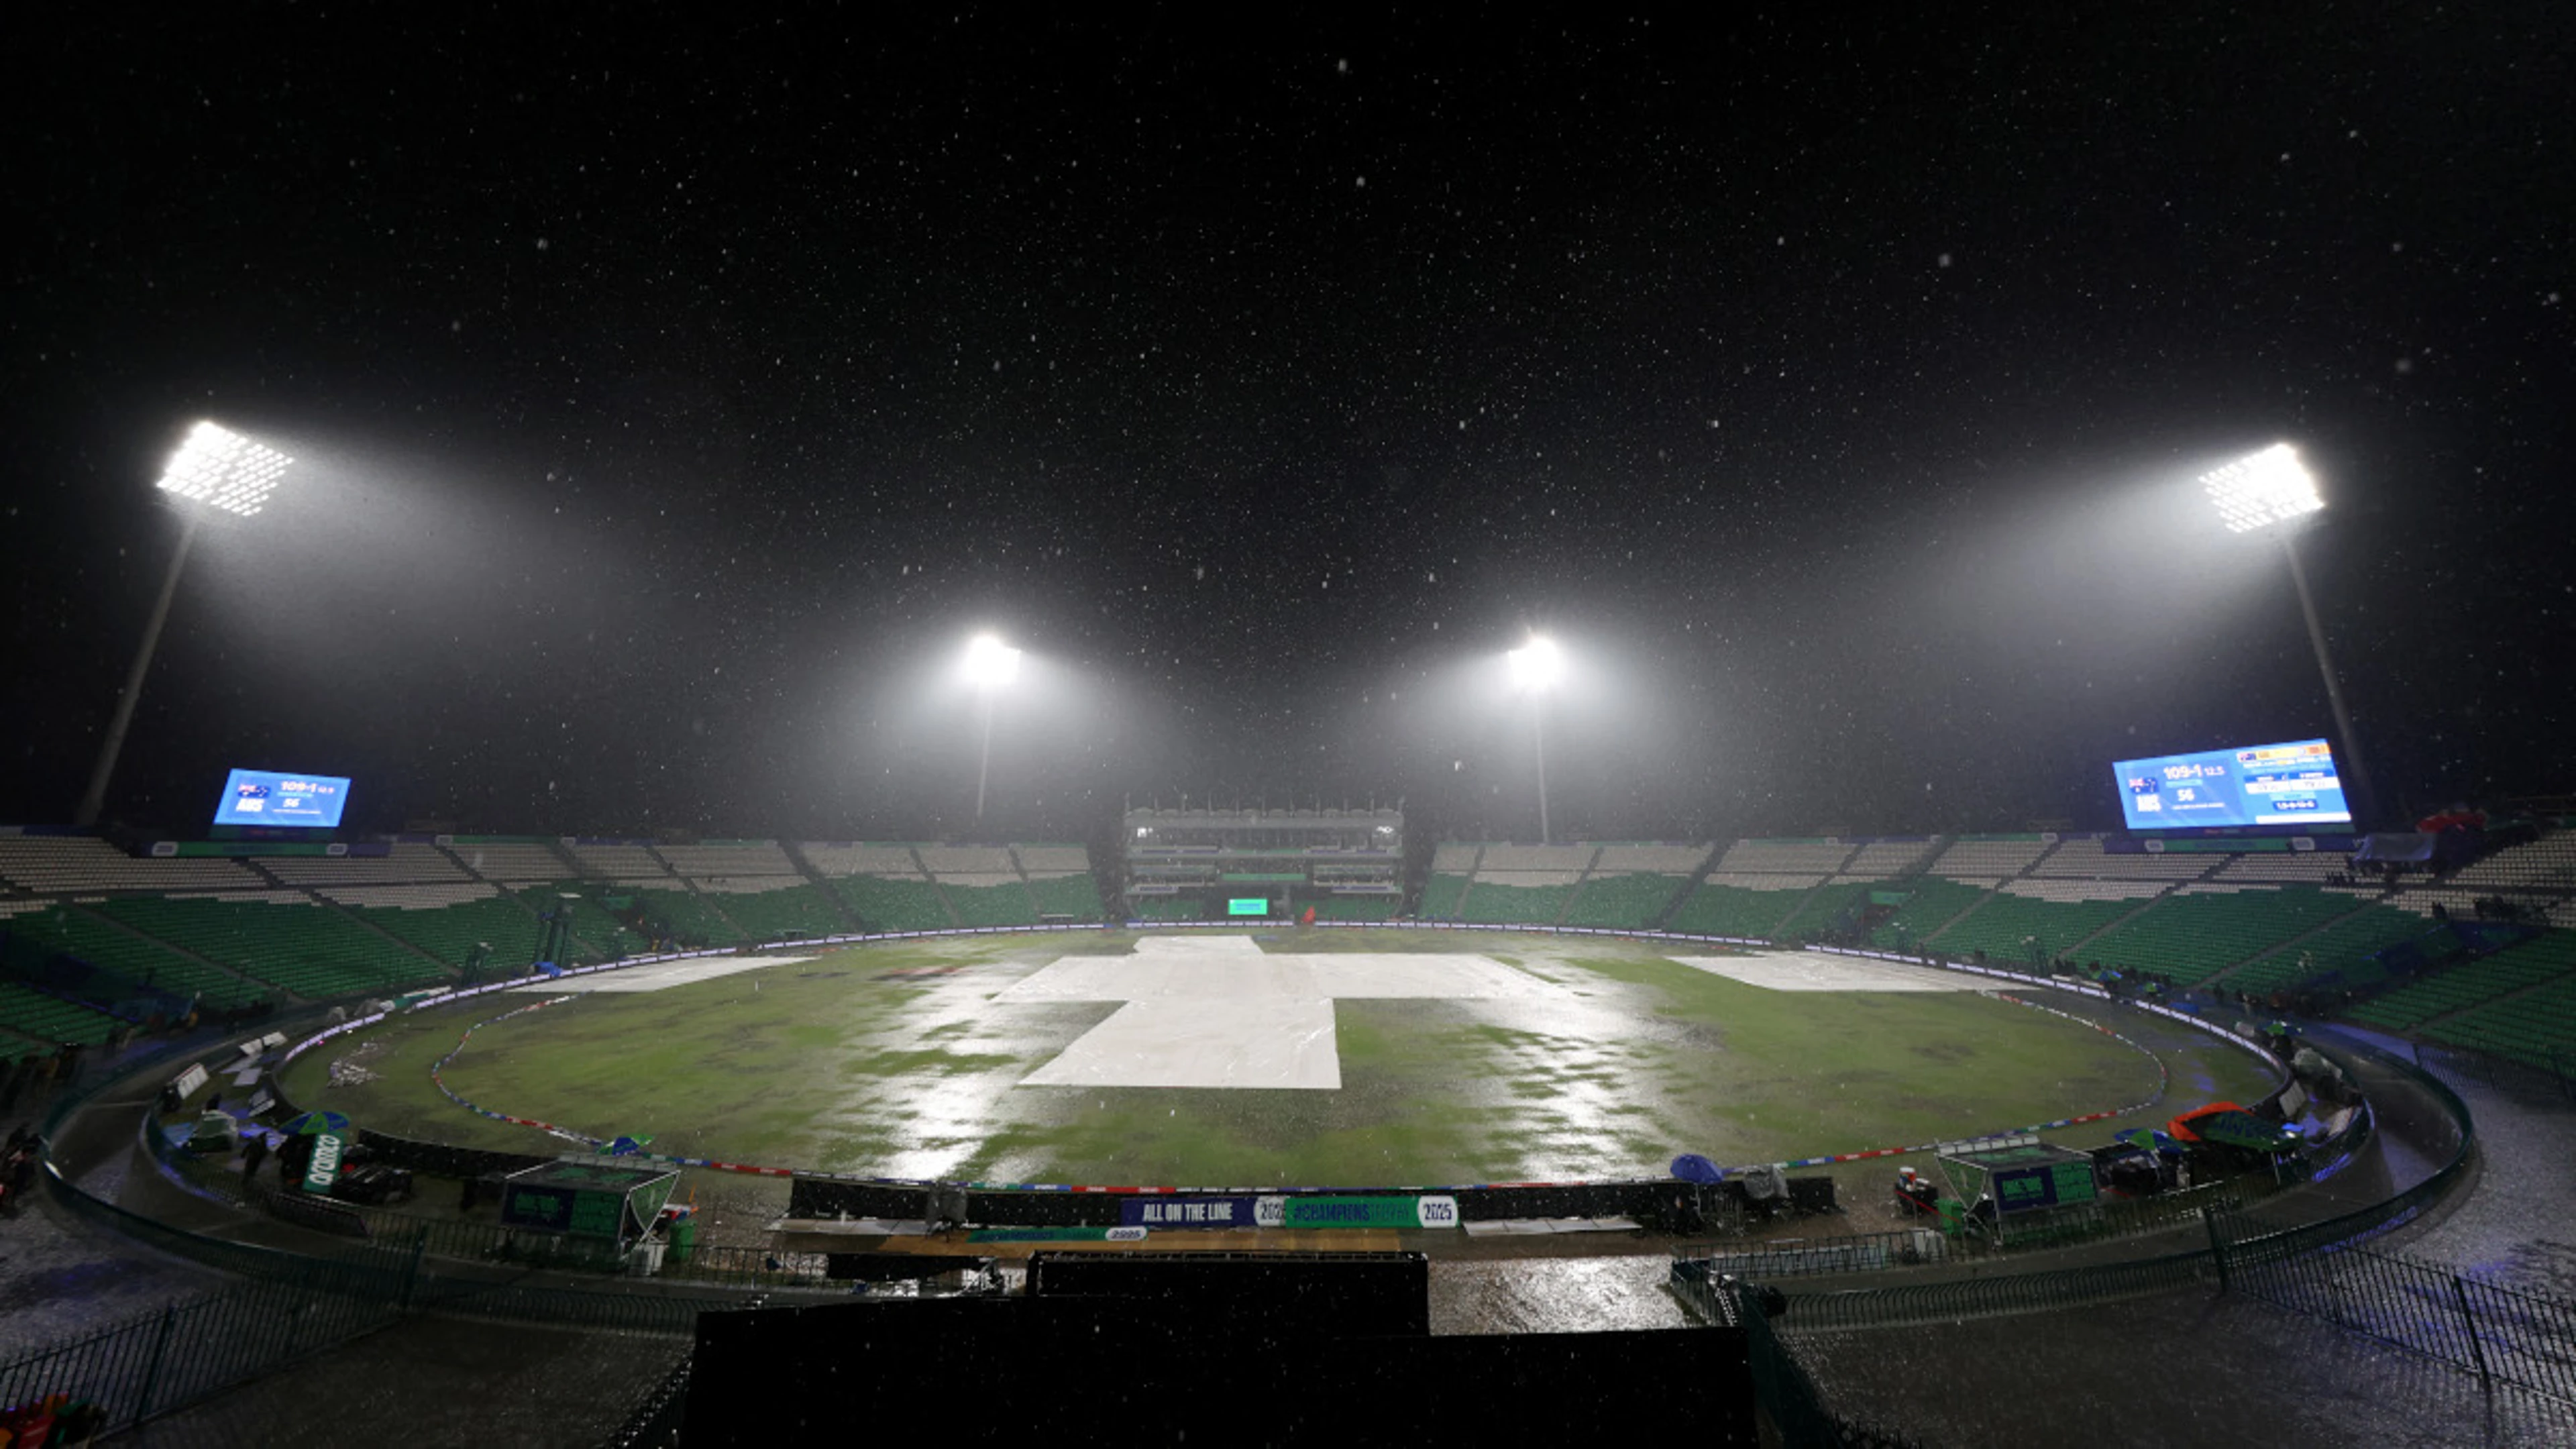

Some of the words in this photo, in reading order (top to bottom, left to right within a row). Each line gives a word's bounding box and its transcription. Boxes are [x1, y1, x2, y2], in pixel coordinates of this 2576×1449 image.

[2163, 763, 2203, 780] 109-1
[280, 781, 317, 792] 109-1
[2177, 788, 2195, 802] 56
[282, 798, 301, 808] 56
[309, 1134, 341, 1185] aramco
[1142, 1203, 1163, 1222] ALL
[1165, 1203, 1183, 1222] ON
[1184, 1203, 1205, 1222] THE
[1208, 1202, 1233, 1221] LINE
[1424, 1203, 1452, 1220] 2025
